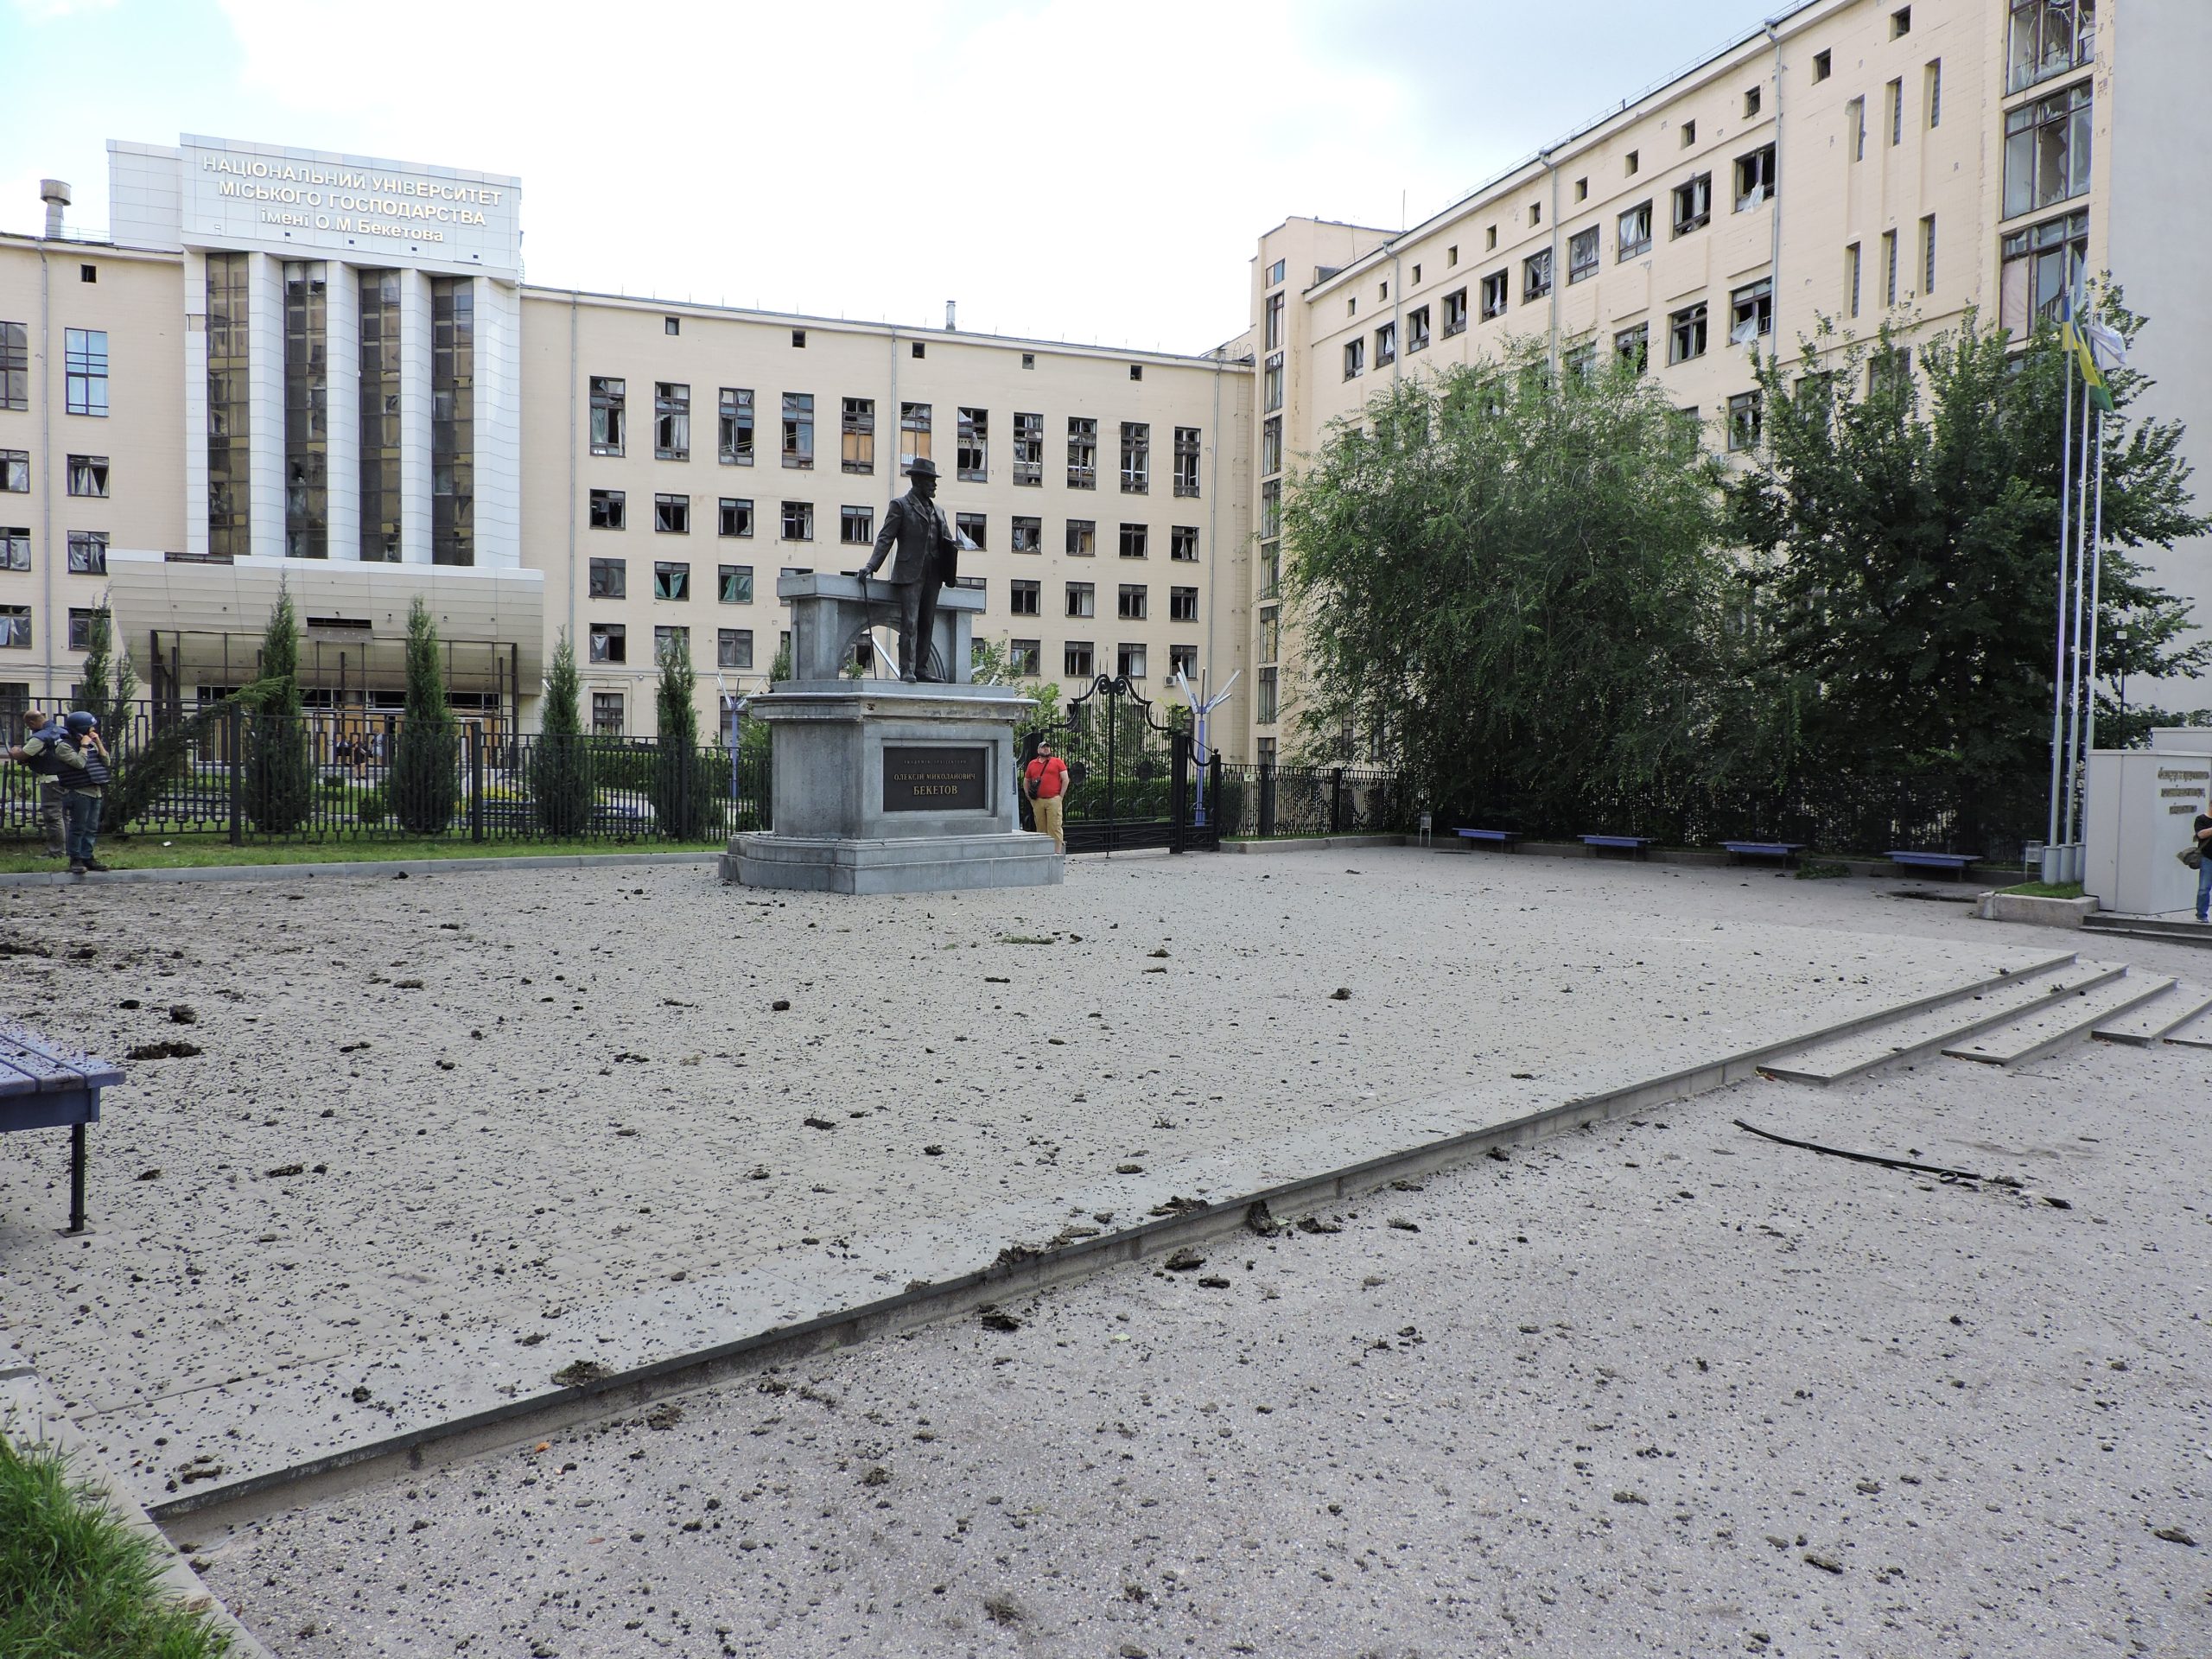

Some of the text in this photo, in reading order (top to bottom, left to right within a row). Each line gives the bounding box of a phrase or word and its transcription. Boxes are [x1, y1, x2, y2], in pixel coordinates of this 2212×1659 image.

[202, 156, 502, 207] НАЦІОНАЛЬНИЙ УНІВЕРСИТЕТ
[219, 180, 486, 226] МІСЬКОГО ГОСПОДАРСТВА
[260, 207, 443, 242] імені О.М.Бекетова
[912, 785, 958, 796] БЕКЕТОВ
